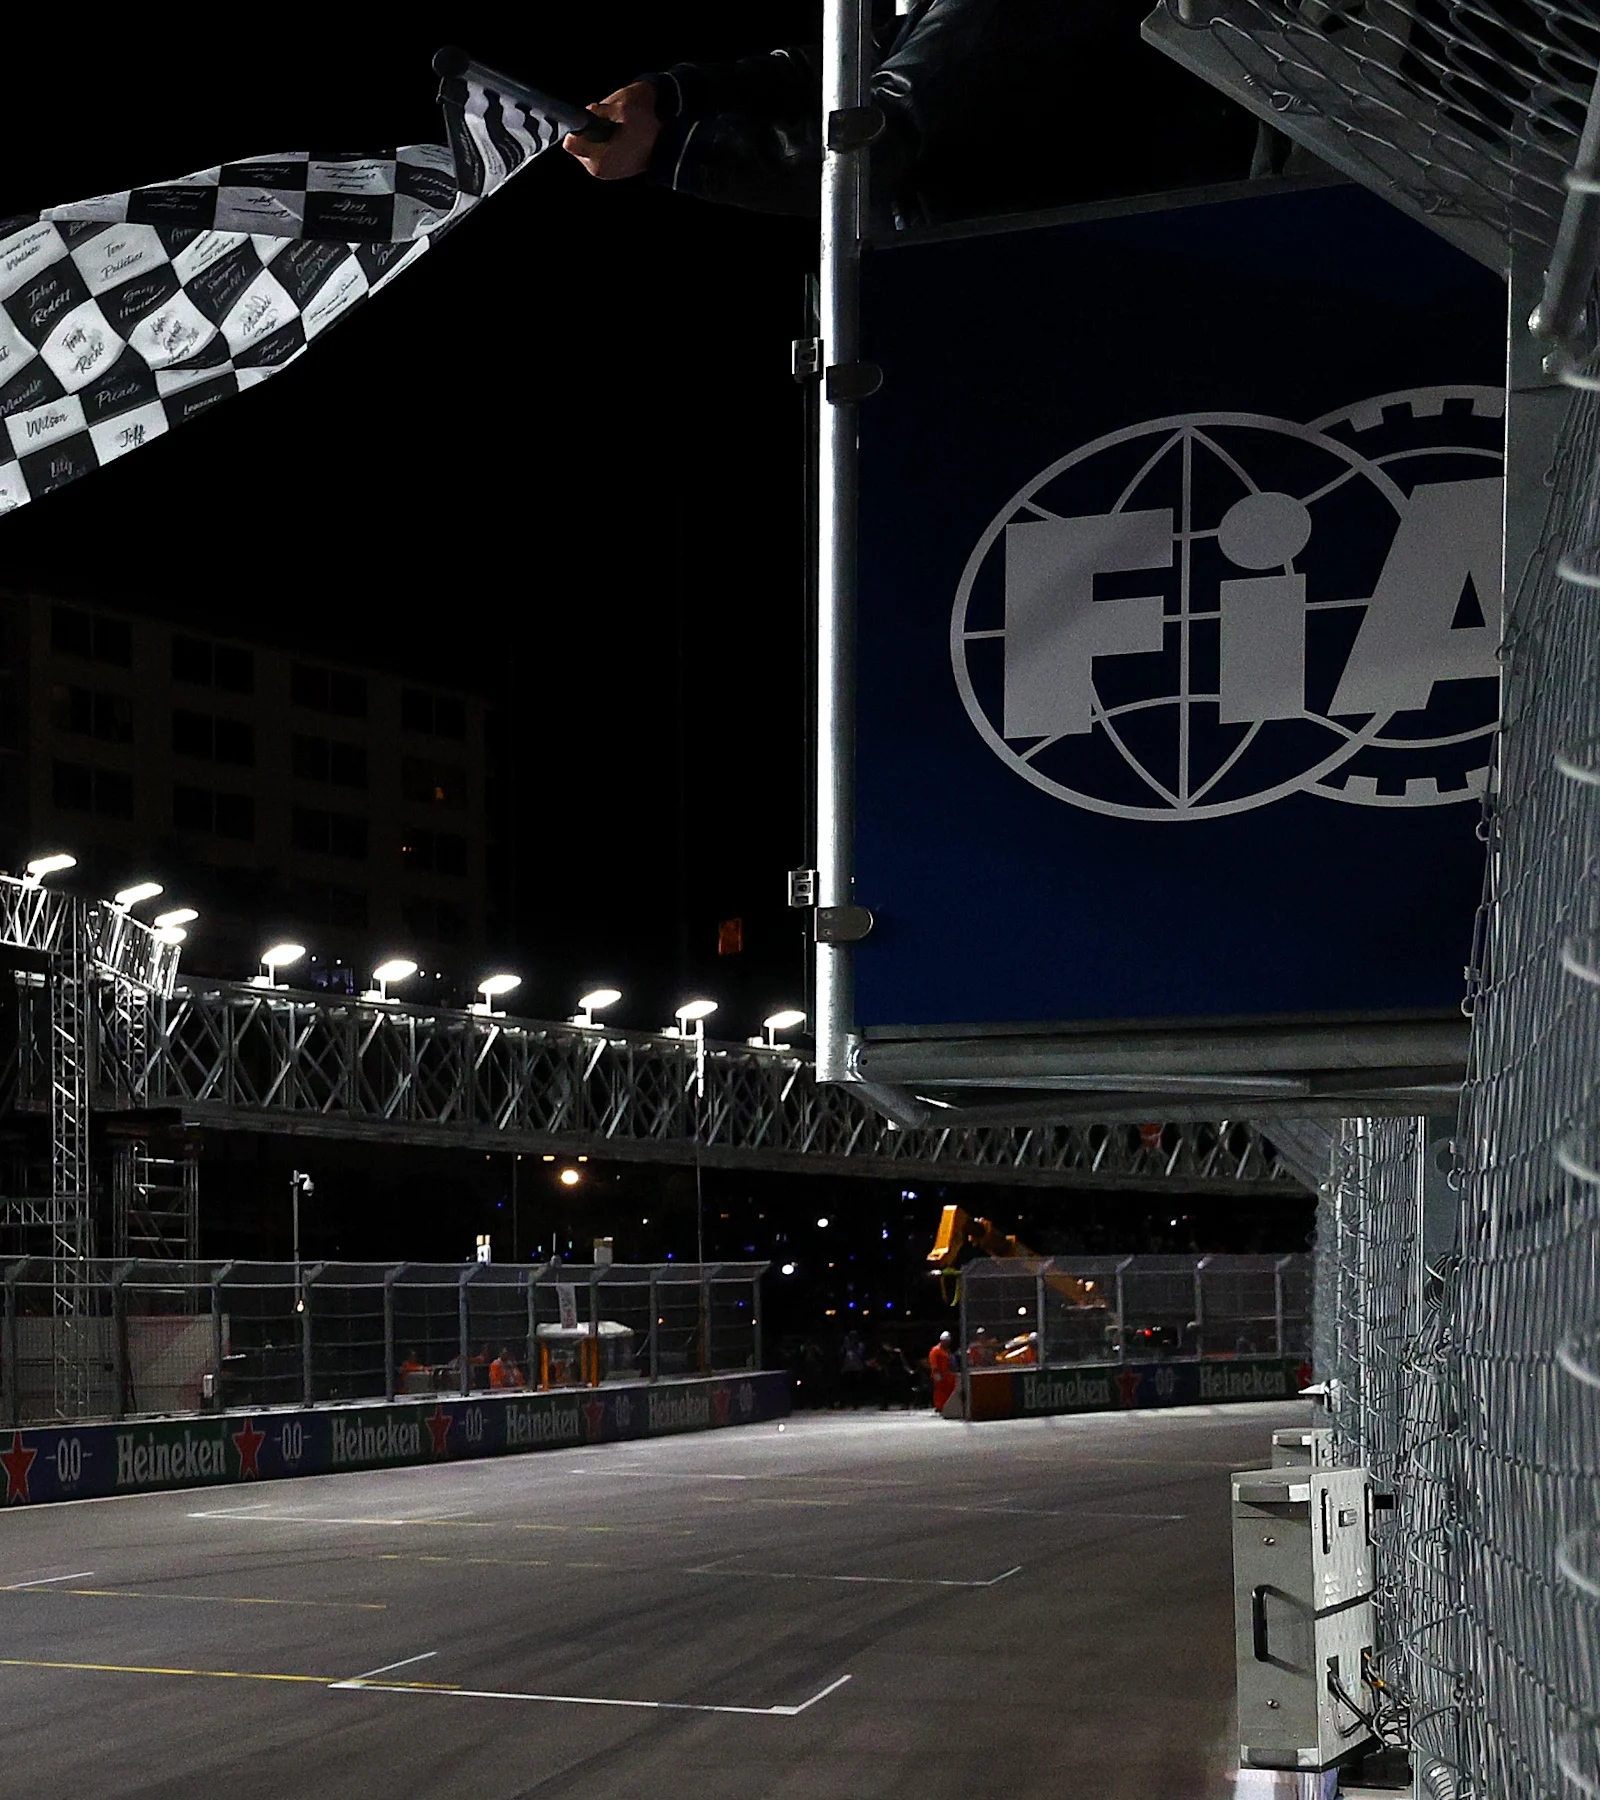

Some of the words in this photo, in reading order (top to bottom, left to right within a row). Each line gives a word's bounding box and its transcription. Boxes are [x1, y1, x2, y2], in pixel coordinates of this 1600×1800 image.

[26, 412, 68, 438] Wilson
[331, 1412, 420, 1465] Heineken
[505, 1403, 580, 1445] Heineken
[57, 1438, 82, 1482] 0.0
[116, 1429, 228, 1485] Heineken
